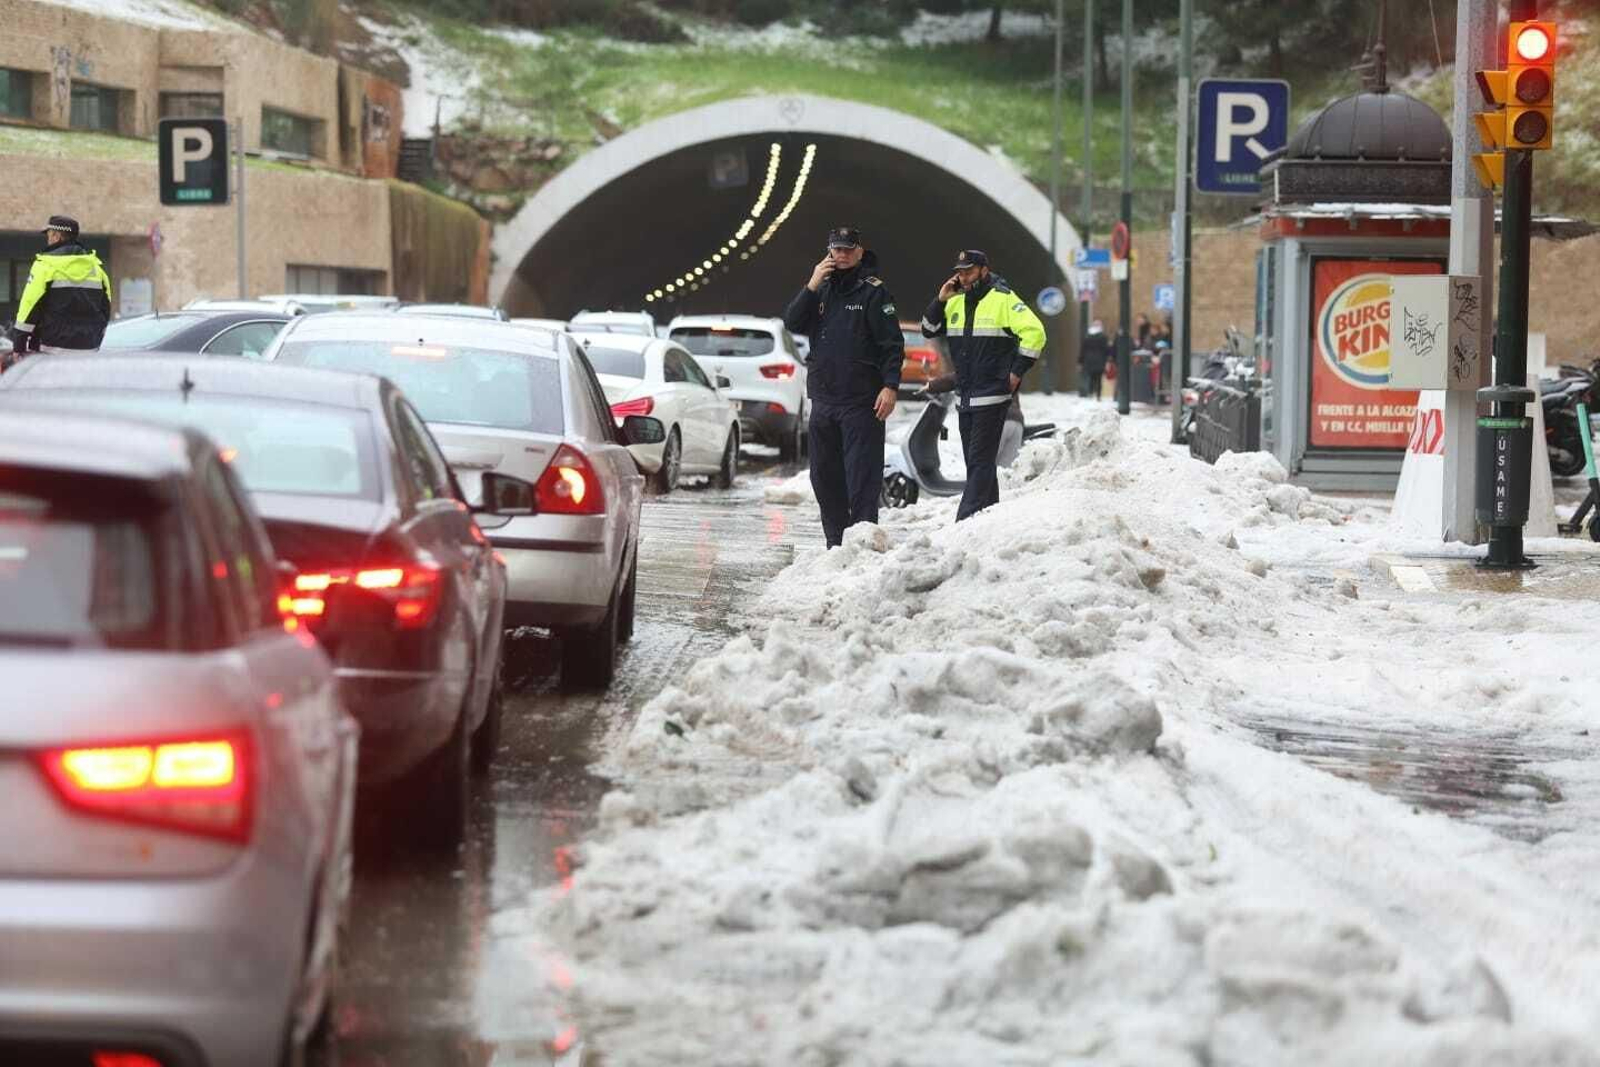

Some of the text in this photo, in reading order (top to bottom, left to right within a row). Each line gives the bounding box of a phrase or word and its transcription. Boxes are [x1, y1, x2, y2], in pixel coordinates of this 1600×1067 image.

[172, 127, 213, 182] P
[1334, 301, 1391, 335] BURG
[1338, 323, 1390, 362] KIN
[1317, 404, 1354, 416] FRENTE
[1357, 404, 1365, 416] A
[1367, 405, 1380, 417] LA
[1320, 421, 1329, 432] Y
[1331, 421, 1345, 433] EN
[1365, 421, 1404, 434] MUELLE
